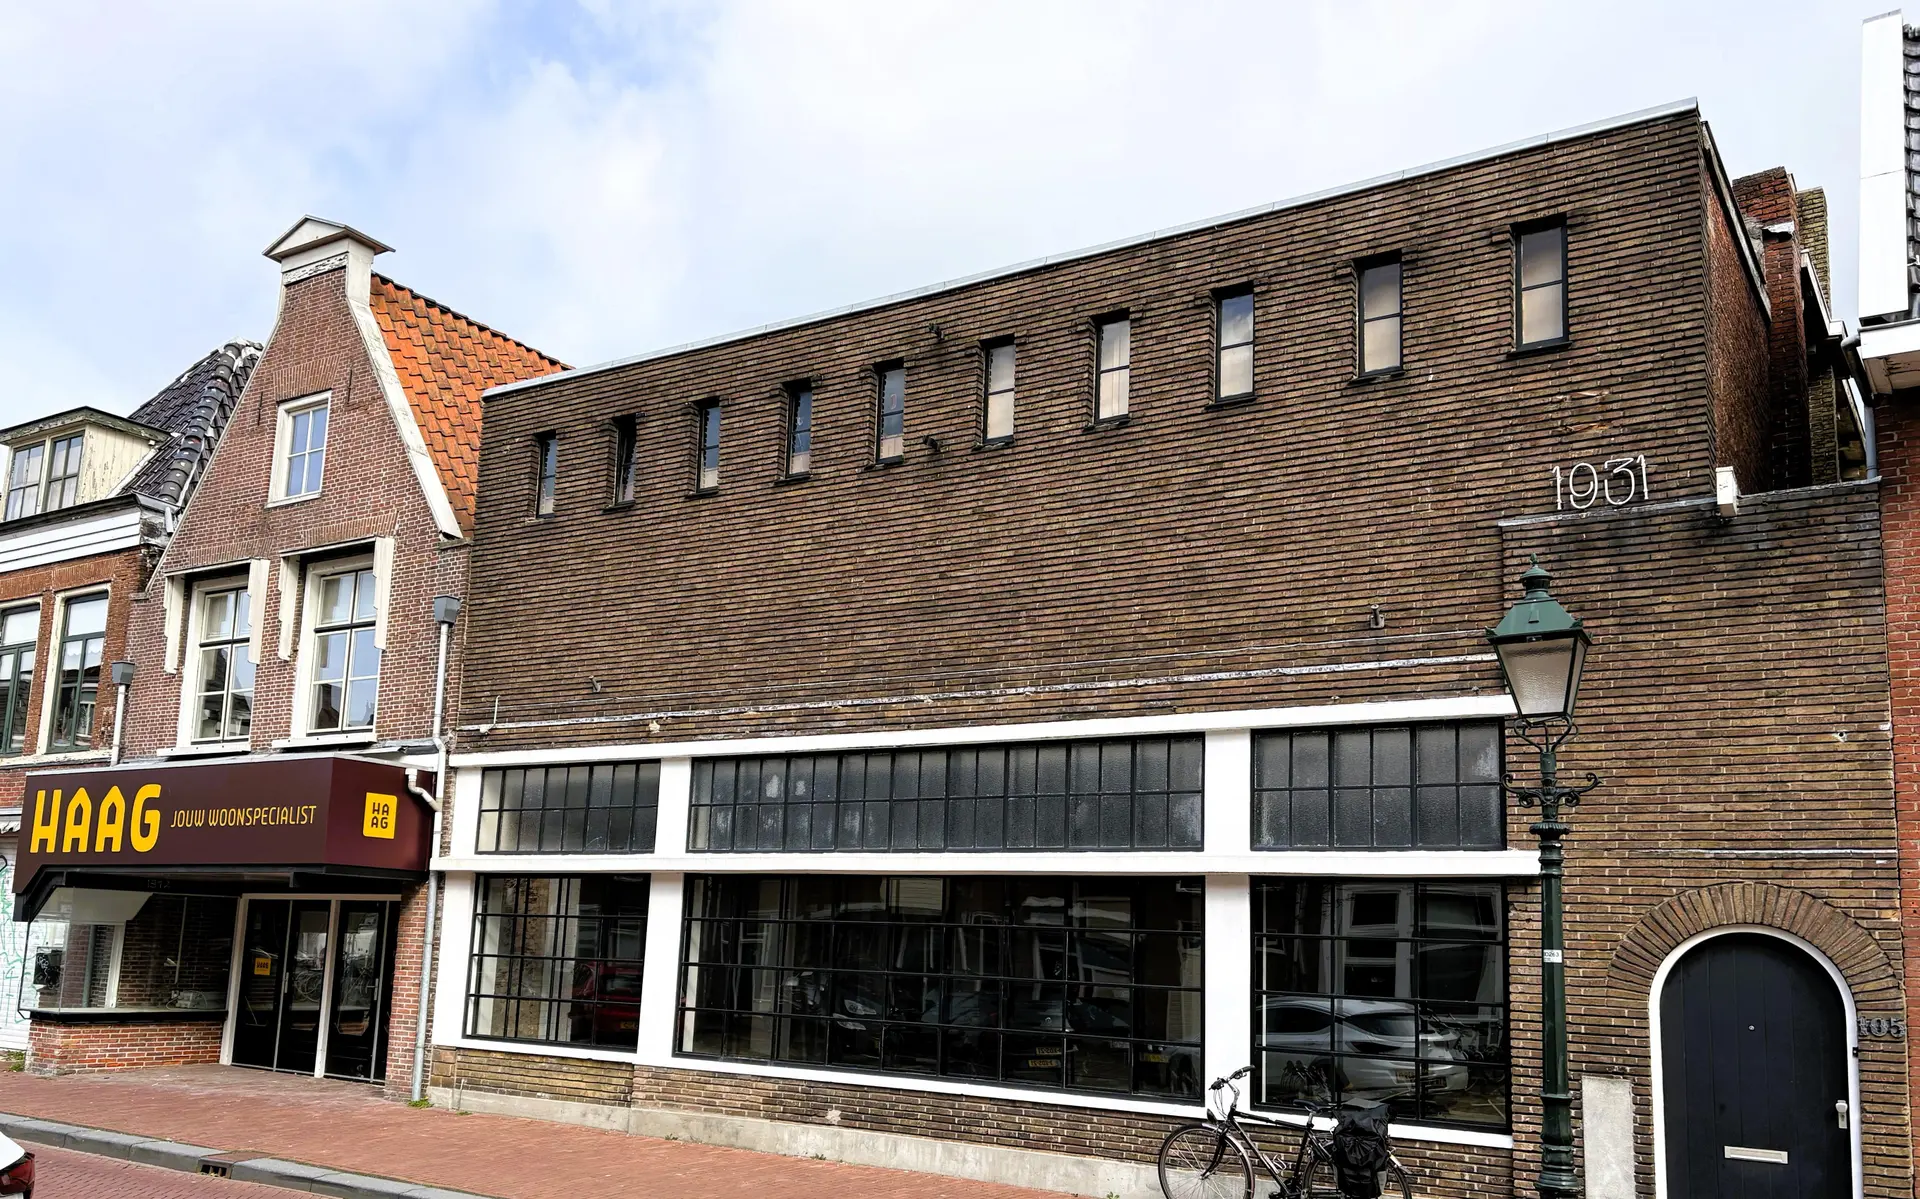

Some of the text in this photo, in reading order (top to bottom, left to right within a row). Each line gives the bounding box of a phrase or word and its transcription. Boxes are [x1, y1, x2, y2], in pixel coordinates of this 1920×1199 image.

[1551, 454, 1649, 510] 1931
[29, 783, 162, 853] HAAG
[170, 805, 317, 828] JOUW WOONSPECIALIST
[372, 801, 390, 816] HA
[371, 815, 389, 829] AG
[1858, 1016, 1906, 1038] 105
